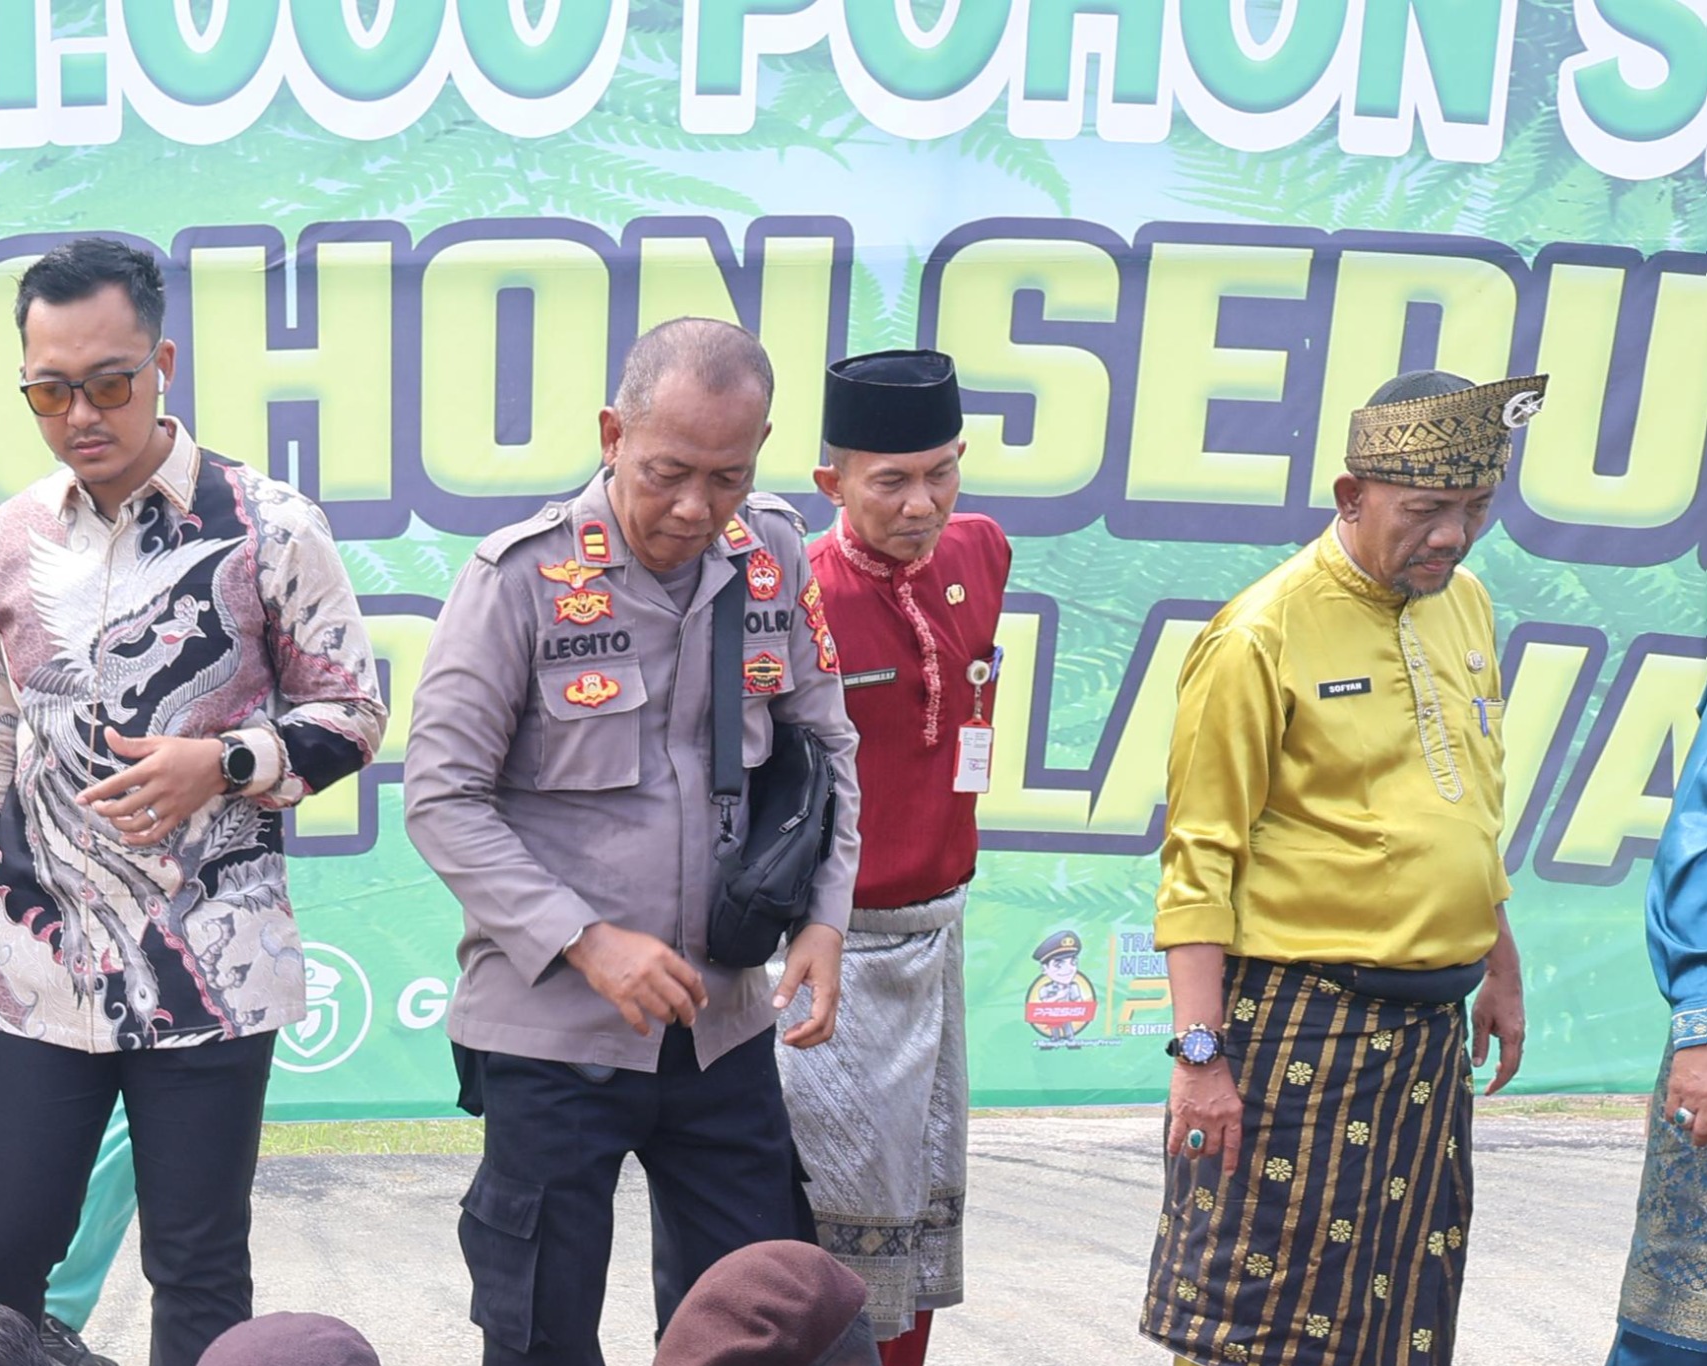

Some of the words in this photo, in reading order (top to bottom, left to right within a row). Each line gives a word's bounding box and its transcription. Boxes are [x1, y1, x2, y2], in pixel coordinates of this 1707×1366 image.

[744, 609, 794, 634] OLR
[544, 630, 631, 660] LEGITO
[1328, 682, 1363, 693] SOFYAN
